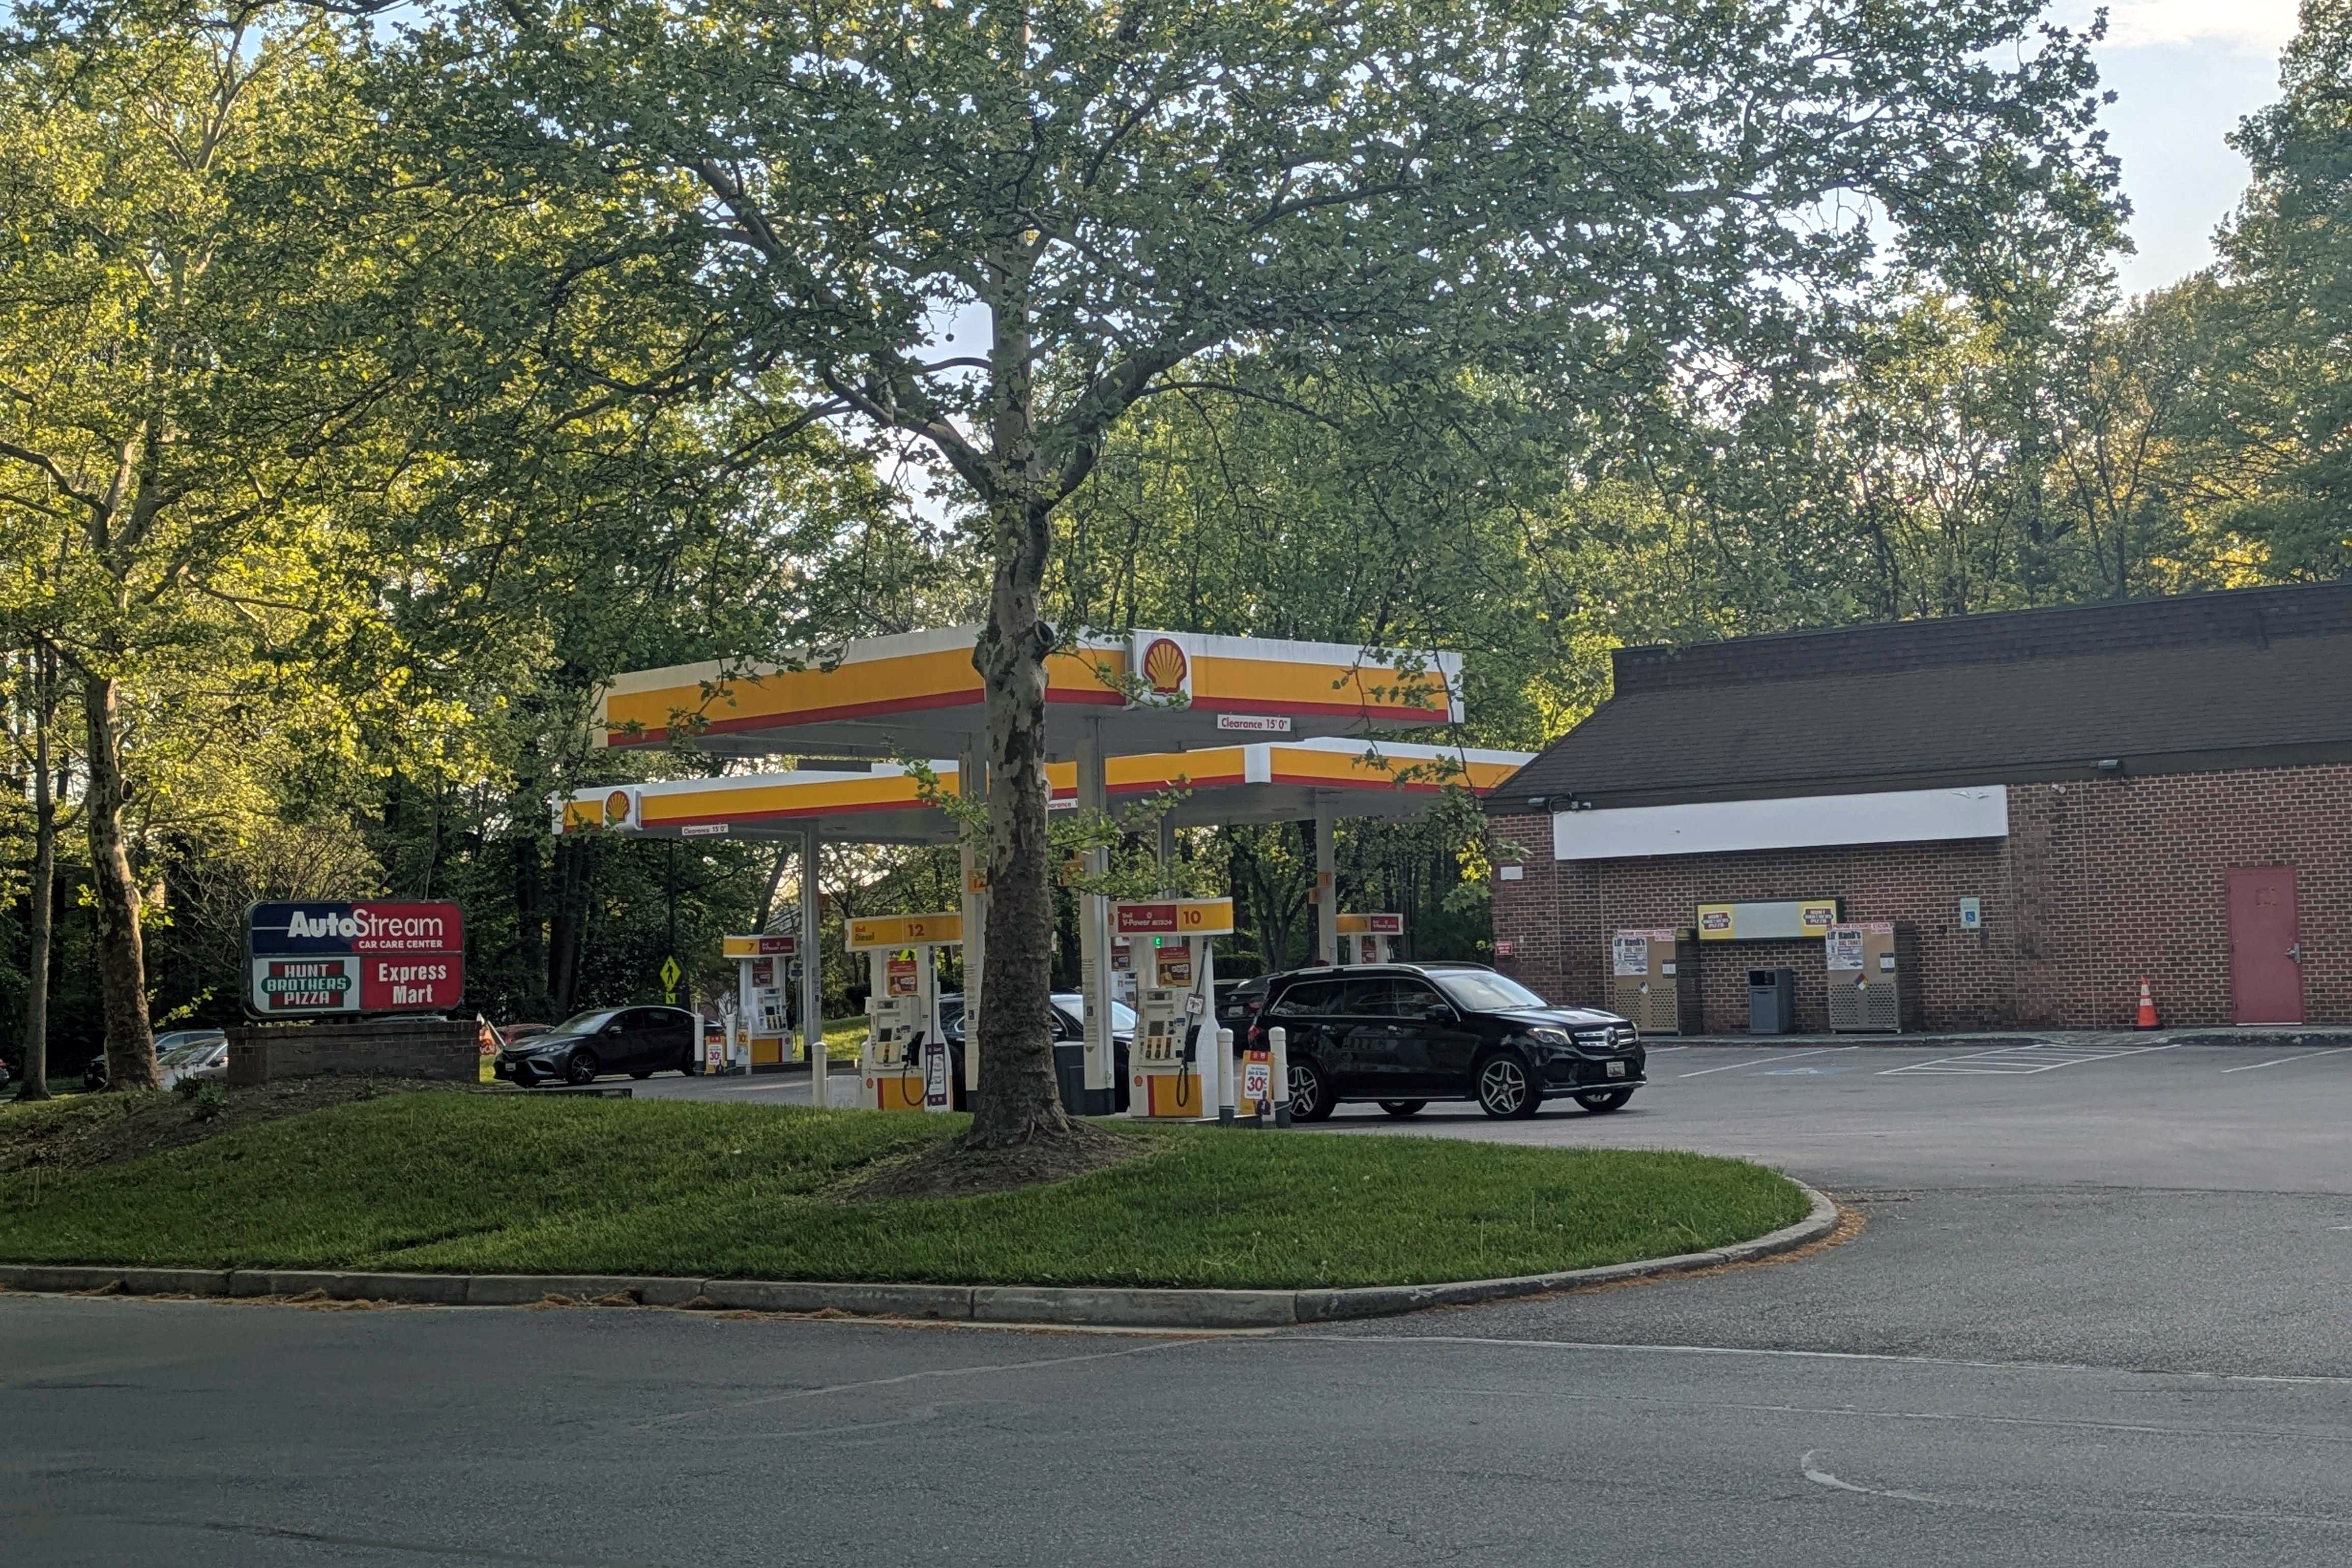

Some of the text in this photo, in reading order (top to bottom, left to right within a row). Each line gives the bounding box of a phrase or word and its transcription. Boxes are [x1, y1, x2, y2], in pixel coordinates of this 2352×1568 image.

[1221, 717, 1262, 729] Clearance
[1266, 719, 1278, 729] 15'
[287, 908, 443, 938] AutoStream
[1183, 910, 1202, 925] 10
[854, 932, 875, 941] Diesel
[908, 924, 925, 937] 12
[359, 939, 443, 949] CAR CARE CENTER
[748, 942, 754, 951] 7
[284, 964, 329, 978] HUNT
[378, 963, 447, 984] Express
[267, 977, 346, 992] BROTHERS
[284, 991, 330, 1005] PIZZA
[392, 984, 433, 1004] Mart
